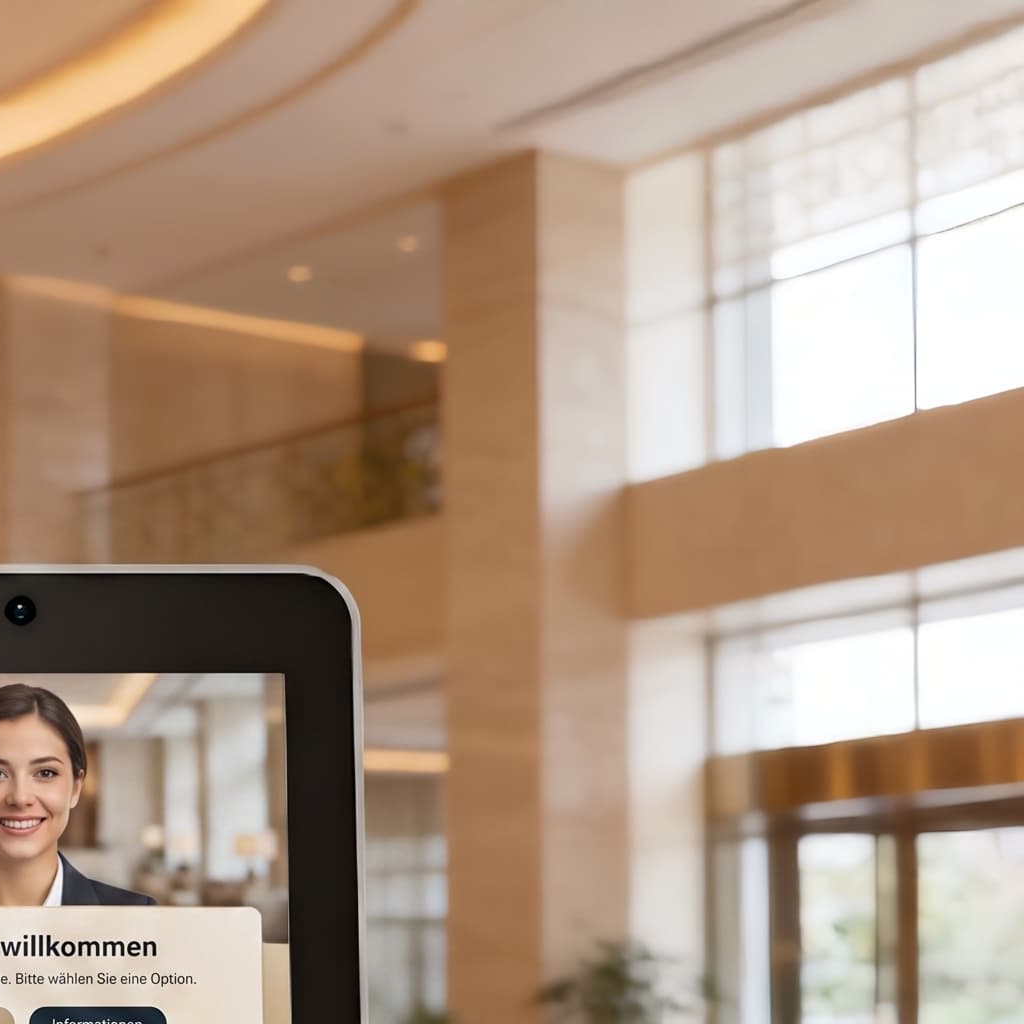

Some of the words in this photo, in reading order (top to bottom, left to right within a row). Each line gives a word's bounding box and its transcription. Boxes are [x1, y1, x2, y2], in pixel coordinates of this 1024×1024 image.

[0, 934, 158, 958] willkommen
[15, 972, 45, 985] Bitte
[48, 972, 94, 985] wählen
[96, 972, 118, 985] Sie
[120, 972, 148, 985] eine
[150, 972, 197, 988] Option.
